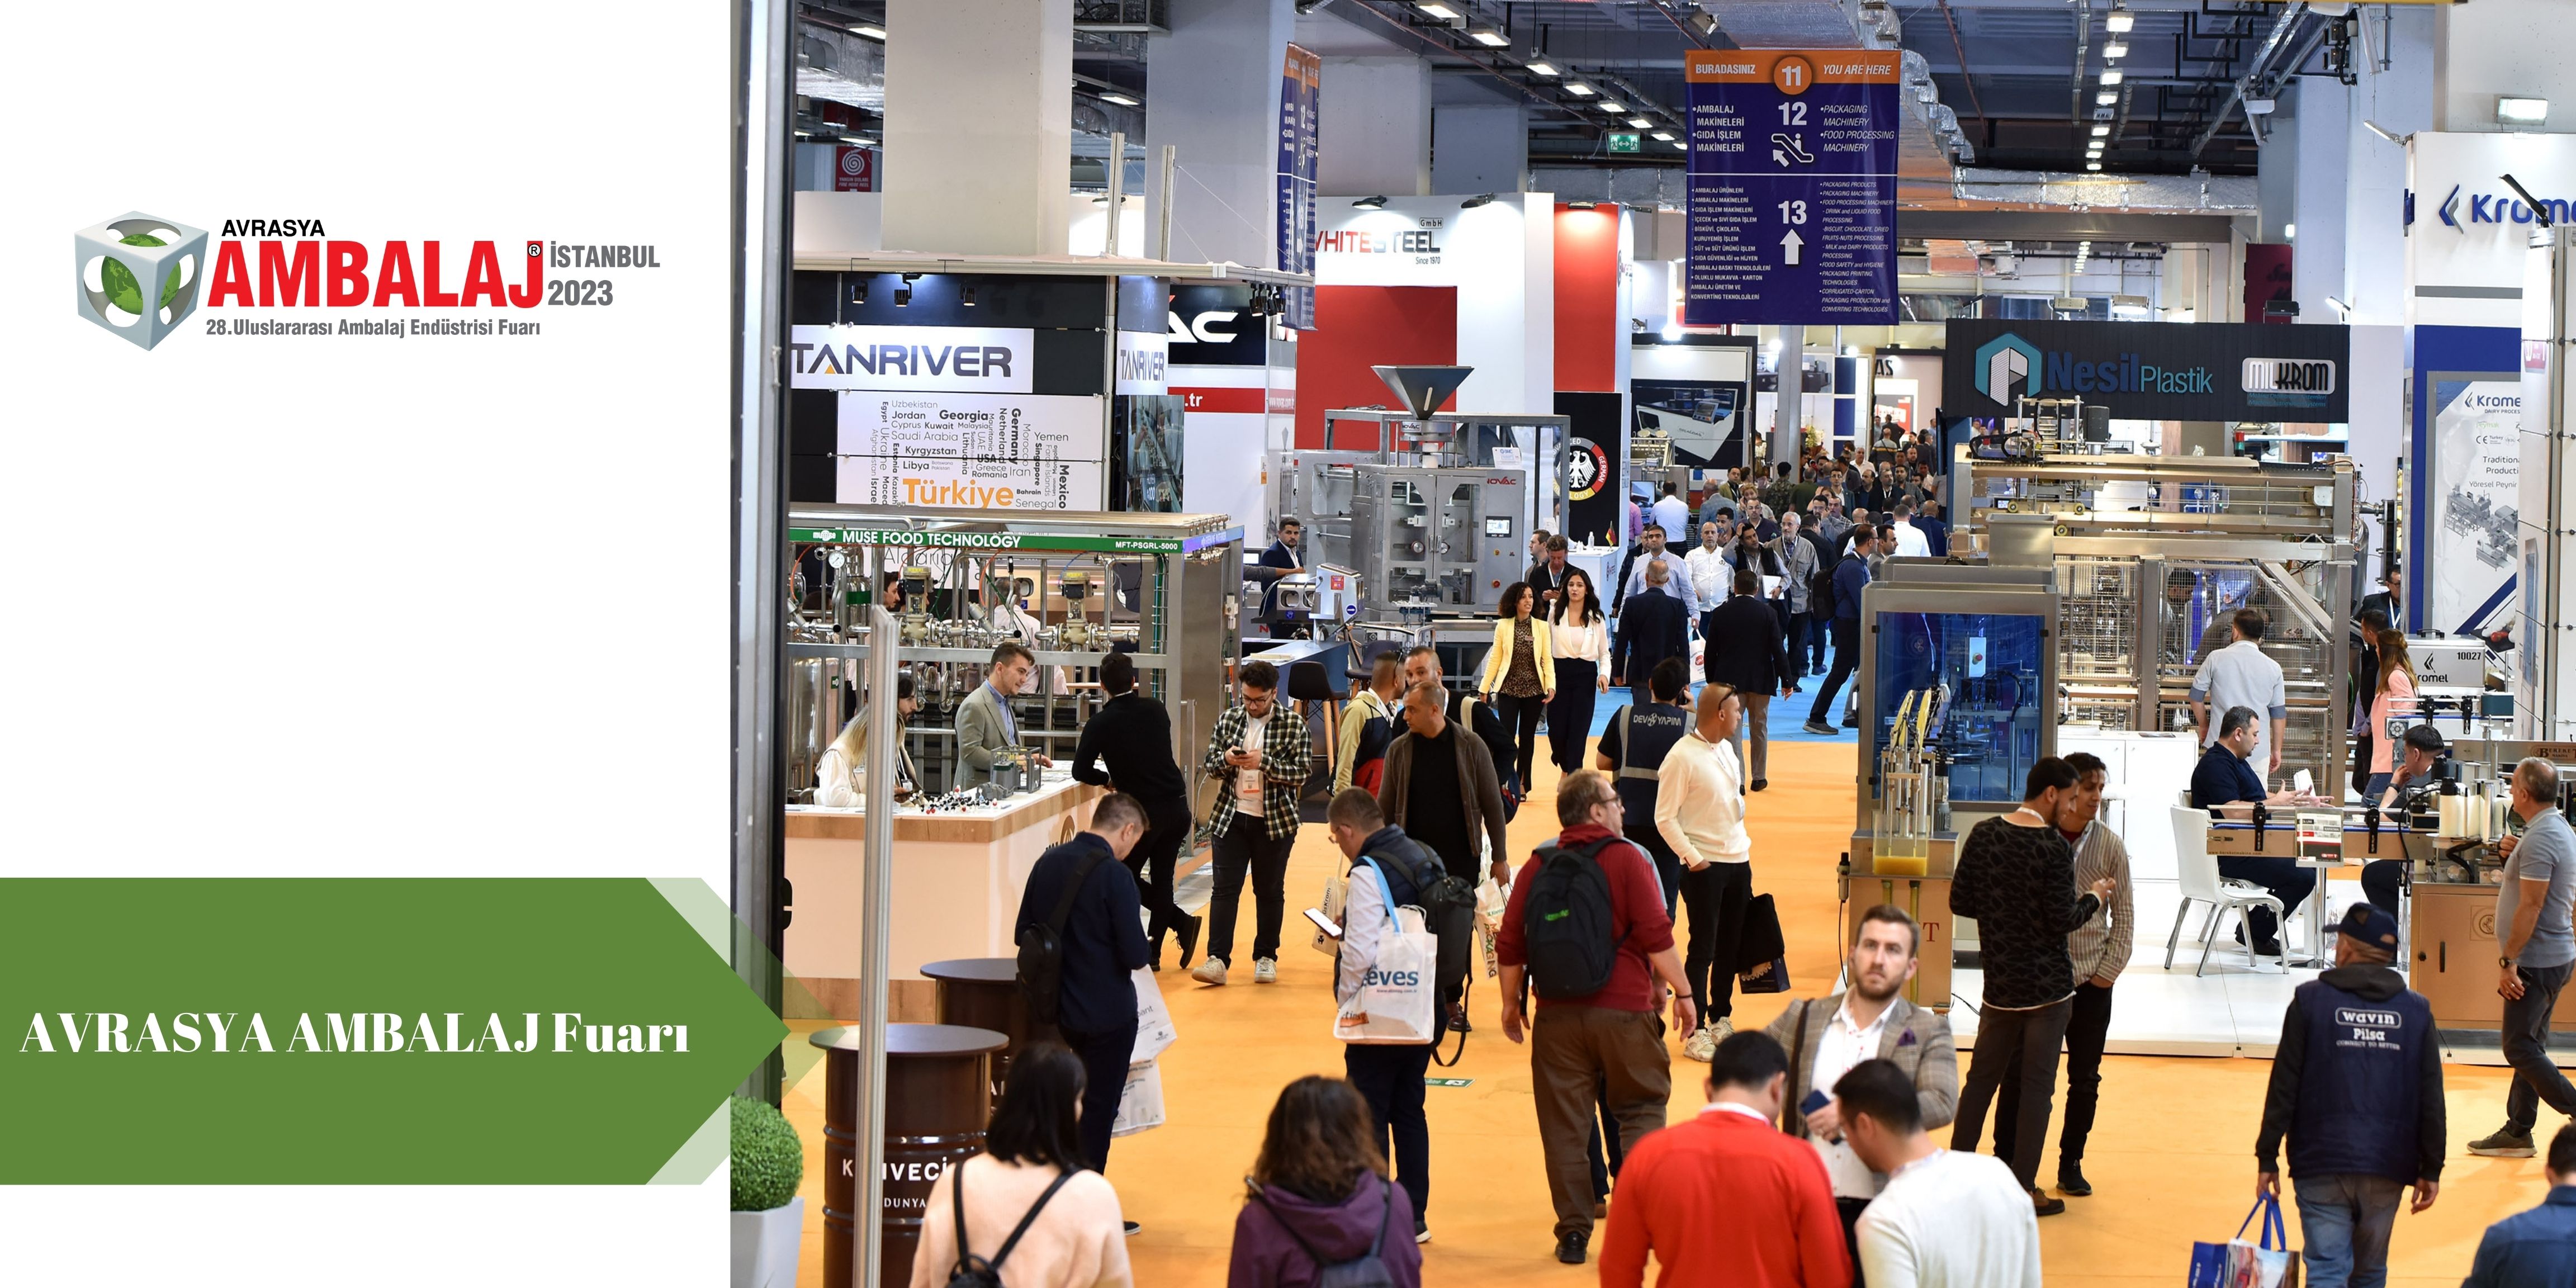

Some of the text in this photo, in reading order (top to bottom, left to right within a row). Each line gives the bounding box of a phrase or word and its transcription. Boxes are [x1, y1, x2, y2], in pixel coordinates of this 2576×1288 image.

[1696, 64, 1756, 74] BURADASINIZ
[1824, 65, 1891, 75] YOU ARE HERE
[1782, 66, 1801, 86] 11
[1697, 105, 1734, 114] AMBALAJ
[1778, 102, 1807, 126] 12
[1824, 105, 1868, 113] PACKAGING
[1697, 116, 1745, 126] MAKİNELERİ
[1824, 117, 1869, 126] MACHINERY
[1697, 129, 1741, 140] GIDA İŞLEM
[1824, 131, 1895, 139] FOOD PROCESSING
[1697, 142, 1745, 152] MAKİNELERİ
[1824, 143, 1869, 152] MACHINERY
[1778, 200, 1807, 225] 13
[1430, 256, 1441, 264] 1970
[792, 343, 1012, 377] TANRIVER
[1120, 349, 1164, 381] TANRIVER
[891, 400, 938, 409] Uzbekistan
[880, 401, 889, 423] Egypt
[892, 411, 926, 420] Jordan
[939, 409, 989, 423] Georgia
[891, 420, 921, 430] Cyprus
[925, 422, 954, 430] Kuwait
[958, 422, 989, 430] Malaysia
[891, 431, 958, 442] Saudi Arabia
[977, 432, 986, 451] UAE
[1008, 408, 1022, 465] Germany
[1034, 432, 1069, 442] Yemen
[880, 427, 890, 471] Ukraine
[1022, 423, 1031, 467] Morocco
[870, 429, 878, 476] Afghanistan
[905, 446, 958, 456] Kyrgyzstan
[962, 432, 970, 476] Lithuania
[977, 453, 997, 463] USA
[903, 461, 930, 472] Libya
[976, 463, 1007, 472] Greece
[1034, 442, 1043, 486] Singapore
[1598, 455, 1608, 483] GERMAN
[1010, 466, 1031, 477] Iran
[1059, 465, 1070, 509] Mexico
[903, 478, 1014, 509] Türkiye
[1016, 499, 1056, 510] Senegal
[843, 531, 1021, 548] MUSE FOOD TECHNOLOGY
[1115, 541, 1178, 550] MFT-PSGRL-5000
[2457, 652, 2482, 661] 10027
[1633, 714, 1682, 727] DEV YAPIM
[2353, 1028, 2386, 1041] Pilsa
[2378, 1041, 2400, 1050] BETTER
